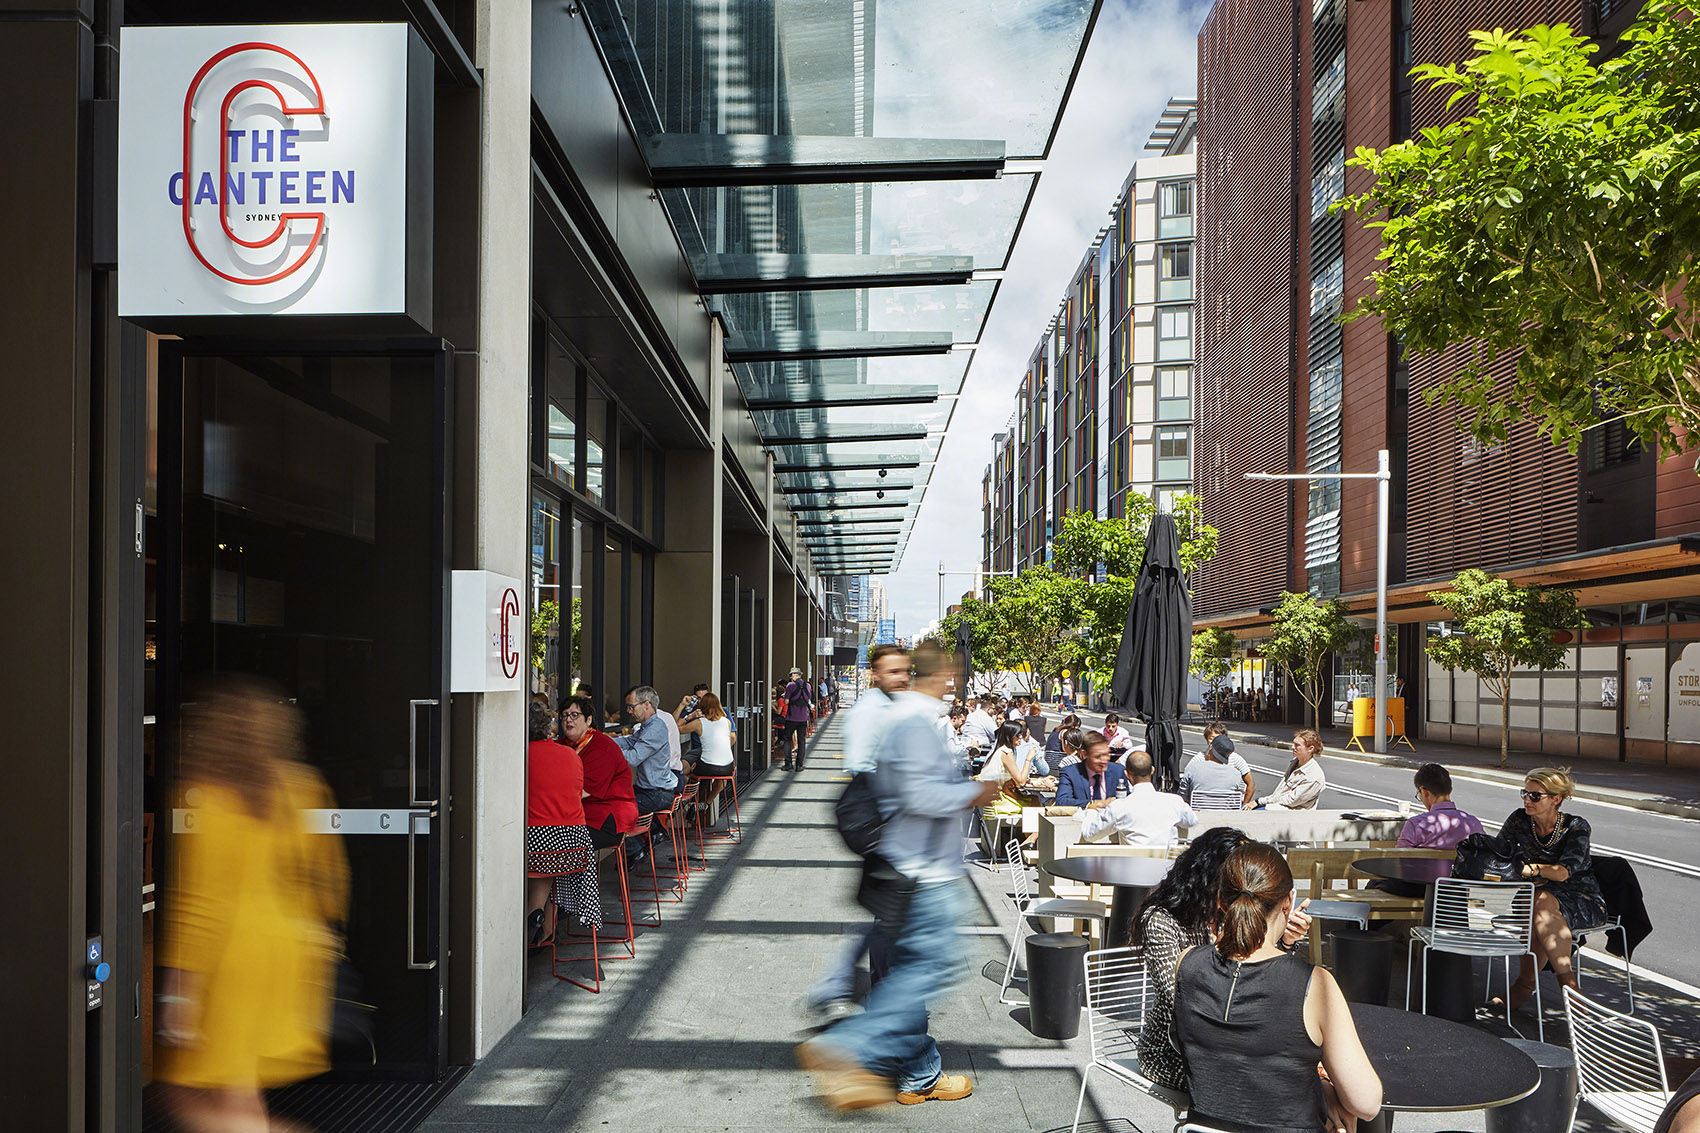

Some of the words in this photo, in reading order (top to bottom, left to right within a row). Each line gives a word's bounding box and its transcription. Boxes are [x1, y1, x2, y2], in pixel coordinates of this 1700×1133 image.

[225, 130, 300, 162] THE
[183, 42, 325, 285] C
[168, 171, 355, 205] CANTEEN
[245, 214, 283, 222] SYDNEY
[500, 588, 520, 678] C
[330, 813, 342, 830] C
[380, 813, 390, 830] C
[88, 983, 100, 992] Push
[88, 998, 100, 1006] open
